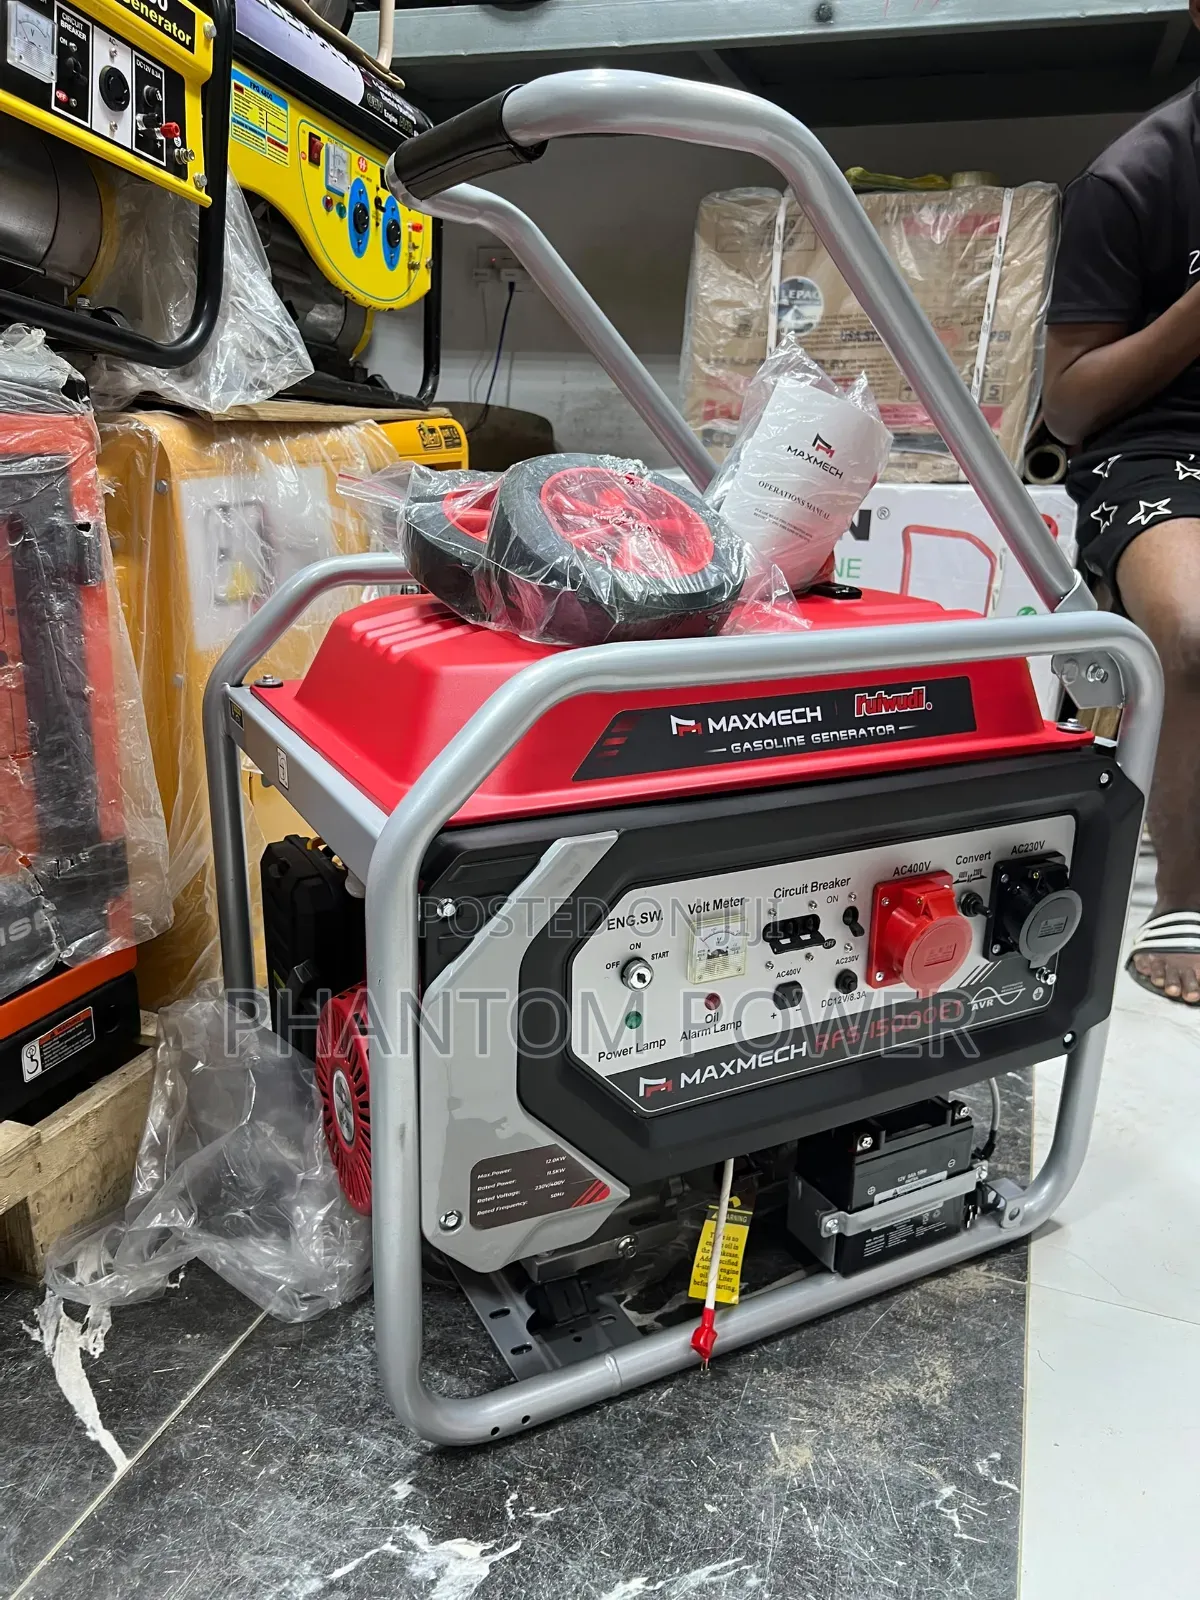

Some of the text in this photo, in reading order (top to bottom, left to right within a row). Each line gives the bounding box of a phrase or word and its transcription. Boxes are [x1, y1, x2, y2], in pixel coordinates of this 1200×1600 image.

[61, 12, 84, 31] CIRCUIT
[60, 19, 87, 42] BREAKER
[59, 36, 68, 46] ON
[56, 90, 67, 101] OFF
[786, 445, 844, 480] MAXMECH
[758, 480, 830, 521] OPERATIONS MANUAL
[707, 706, 823, 734] MAXMECH
[730, 724, 896, 754] GASOLINE GENERATOR
[1010, 839, 1046, 856] AC230V
[955, 850, 992, 866] Convert
[892, 861, 932, 878] AC400V
[773, 876, 852, 899] Circuit Breaker
[687, 896, 746, 915] Volt Meter
[826, 894, 839, 905] ON
[606, 908, 665, 931] ENG.SW.
[629, 941, 642, 952] ON
[823, 939, 836, 949] OFF
[650, 950, 670, 962] START
[835, 954, 860, 966] AC230V
[605, 960, 621, 971] OFF
[775, 967, 802, 980] AC400V
[820, 990, 867, 1008] DC12V/8.3A
[971, 999, 994, 1012] AVR
[704, 1011, 720, 1024] Oil
[679, 1018, 743, 1043] Alarm Lamp
[597, 1038, 667, 1063] Power Lamp
[680, 1041, 807, 1089] MAXMECH
[476, 1183, 496, 1192] Rated
[496, 1179, 517, 1188] Power:
[476, 1195, 496, 1204] Rated
[496, 1190, 521, 1201] Voltage:
[476, 1208, 495, 1217] Rated
[726, 1214, 748, 1223] ARNING
